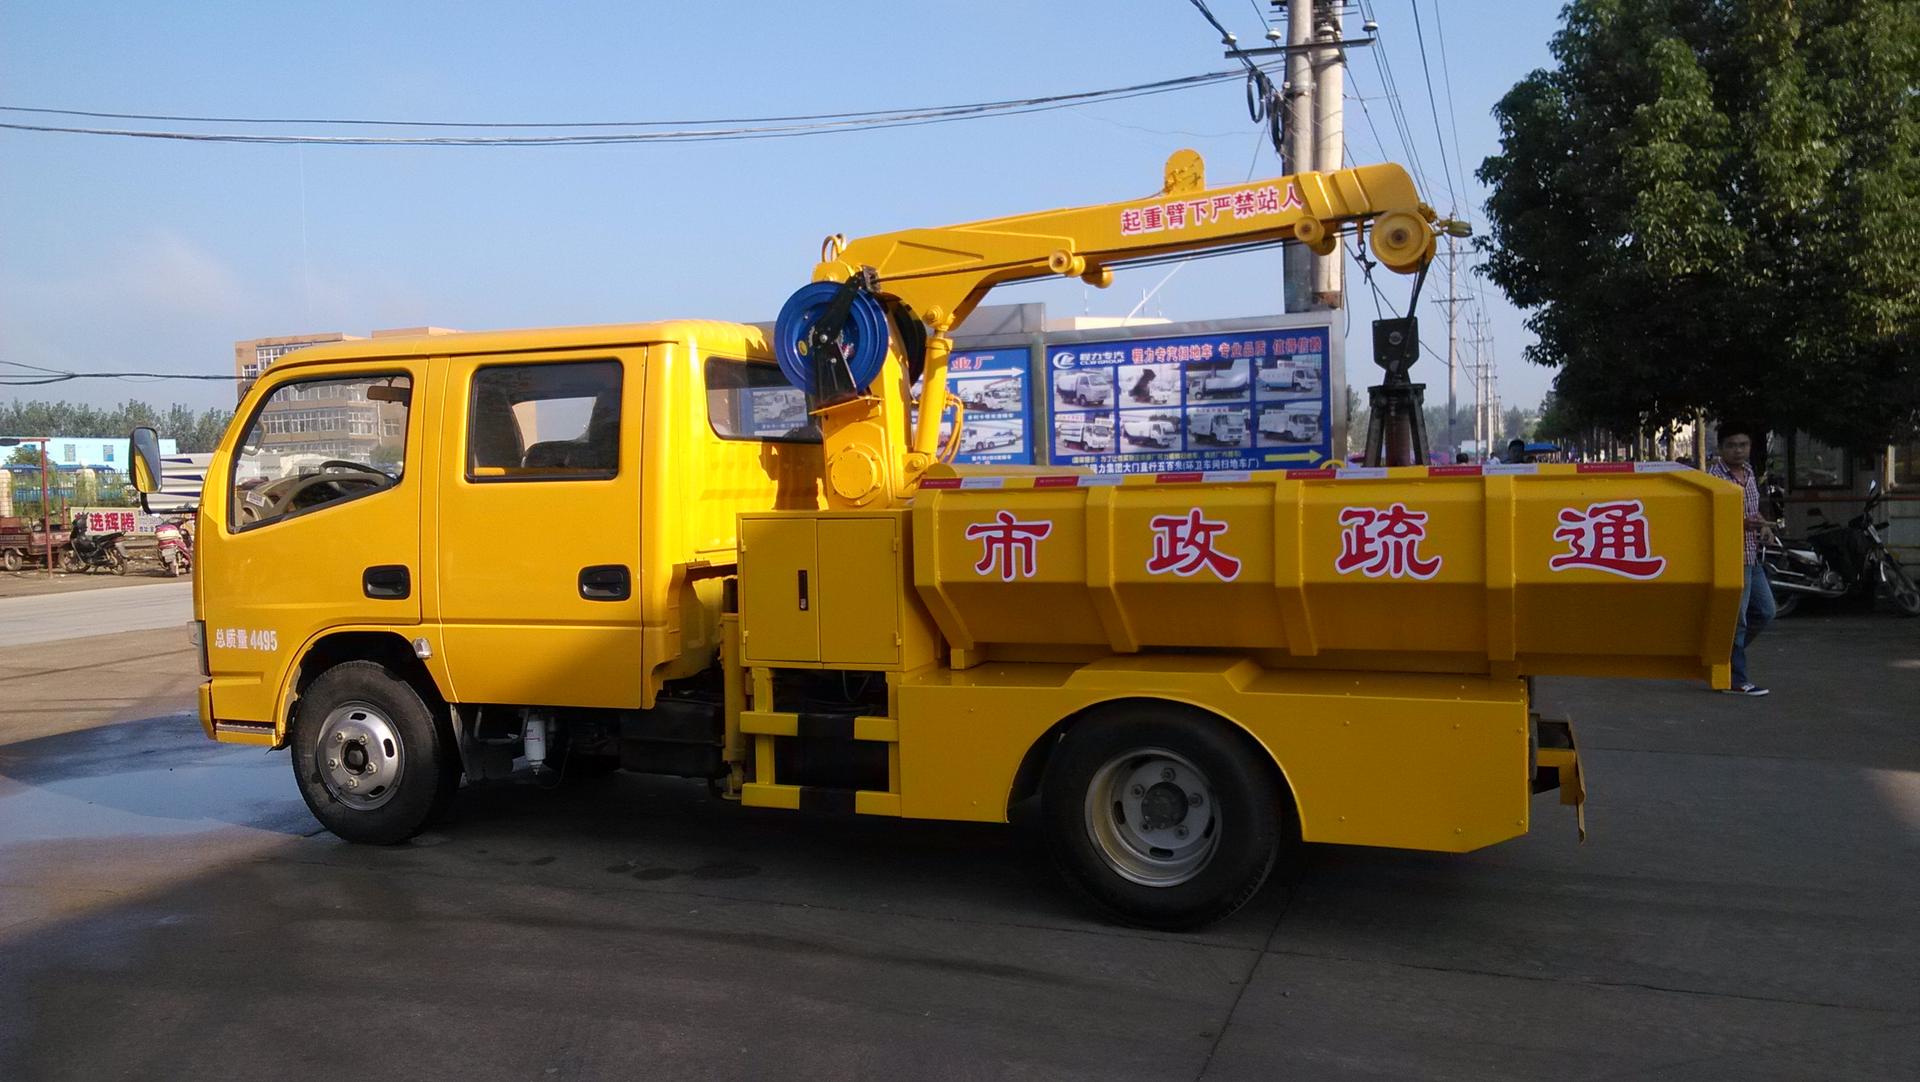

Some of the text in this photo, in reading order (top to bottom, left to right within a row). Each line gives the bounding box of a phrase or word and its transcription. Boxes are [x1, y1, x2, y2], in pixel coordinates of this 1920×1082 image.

[1121, 184, 1304, 236] 起重臂下严禁站人
[965, 499, 1667, 583] 市政疏通
